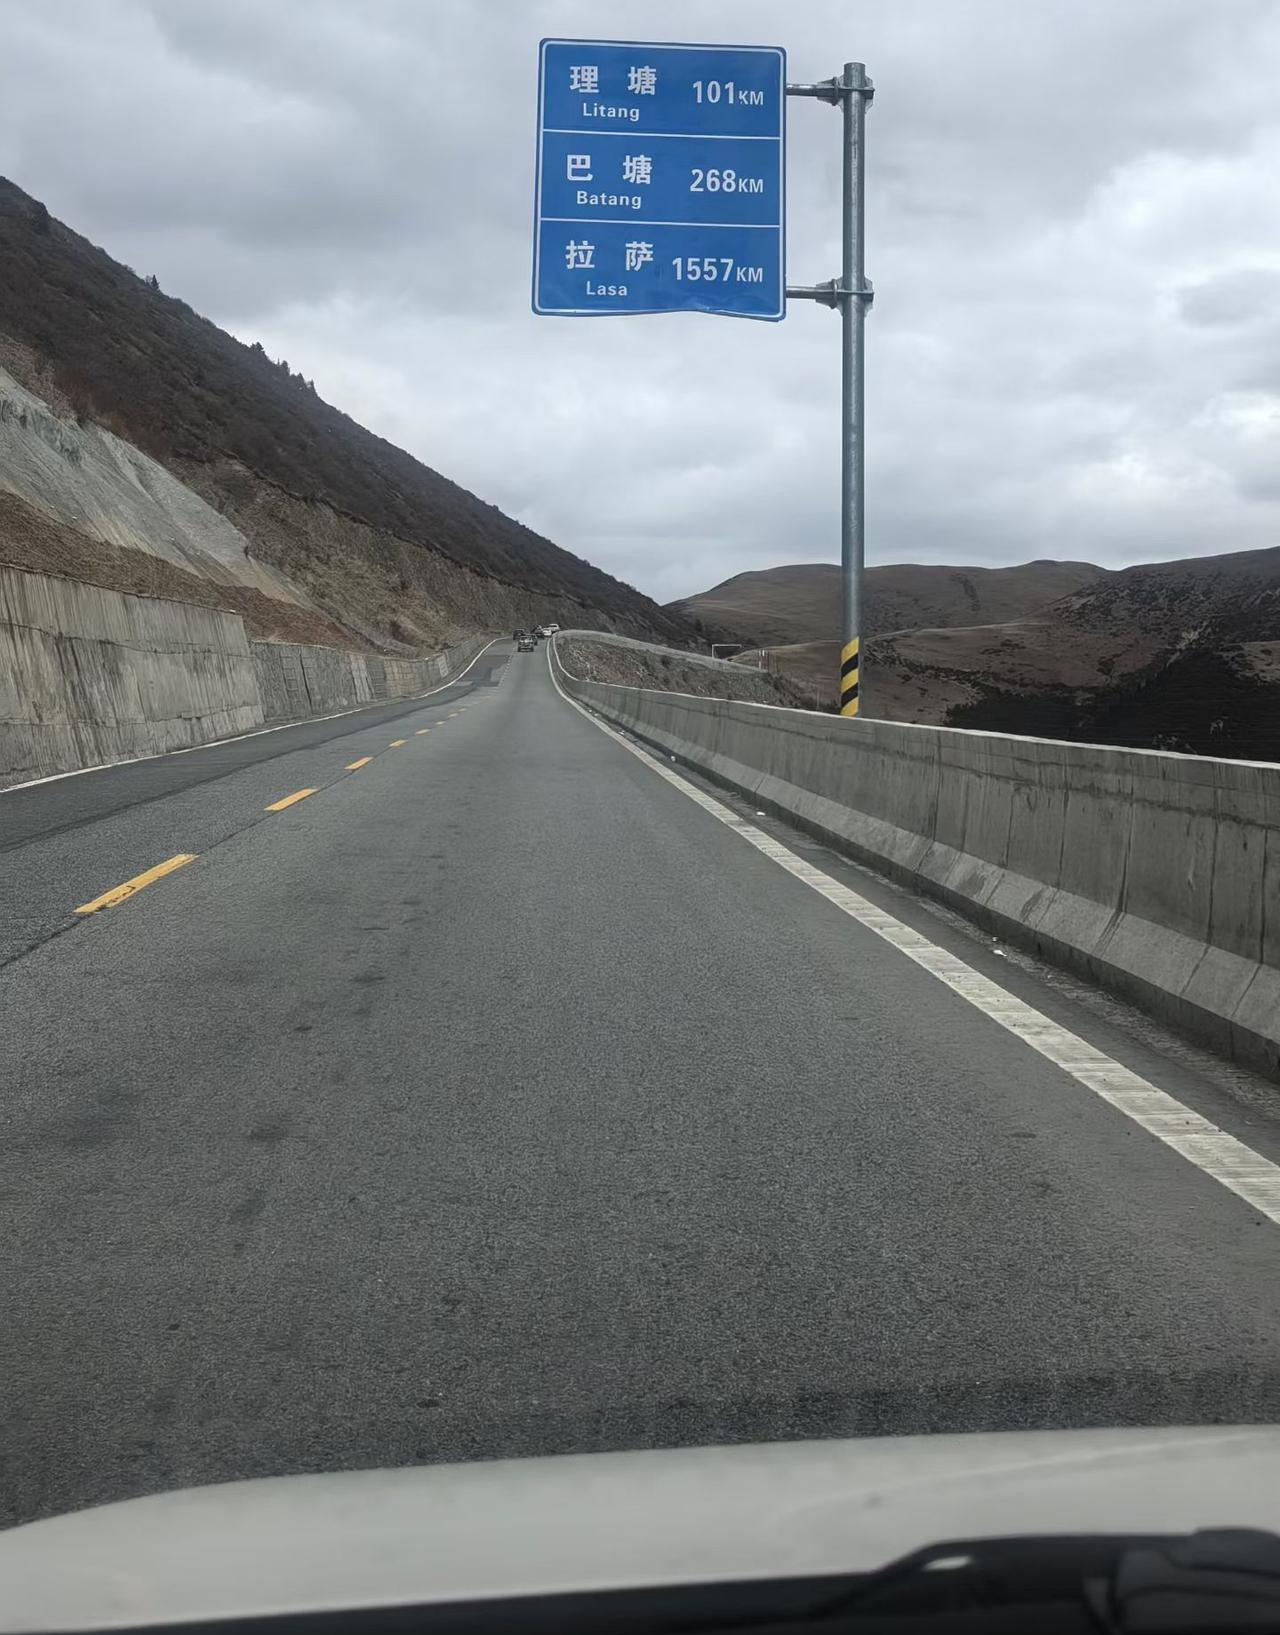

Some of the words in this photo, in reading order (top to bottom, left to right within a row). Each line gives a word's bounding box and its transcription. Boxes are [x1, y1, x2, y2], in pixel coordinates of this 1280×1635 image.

[569, 65, 657, 96] 理塘
[692, 80, 764, 106] 101KM
[583, 102, 640, 122] Litang
[566, 154, 652, 185] 巴塘
[689, 168, 764, 193] 268KM
[576, 190, 642, 210] Batang
[565, 239, 654, 272] 拉萨
[672, 257, 763, 283] 1557KM
[586, 281, 628, 297] Lasa
